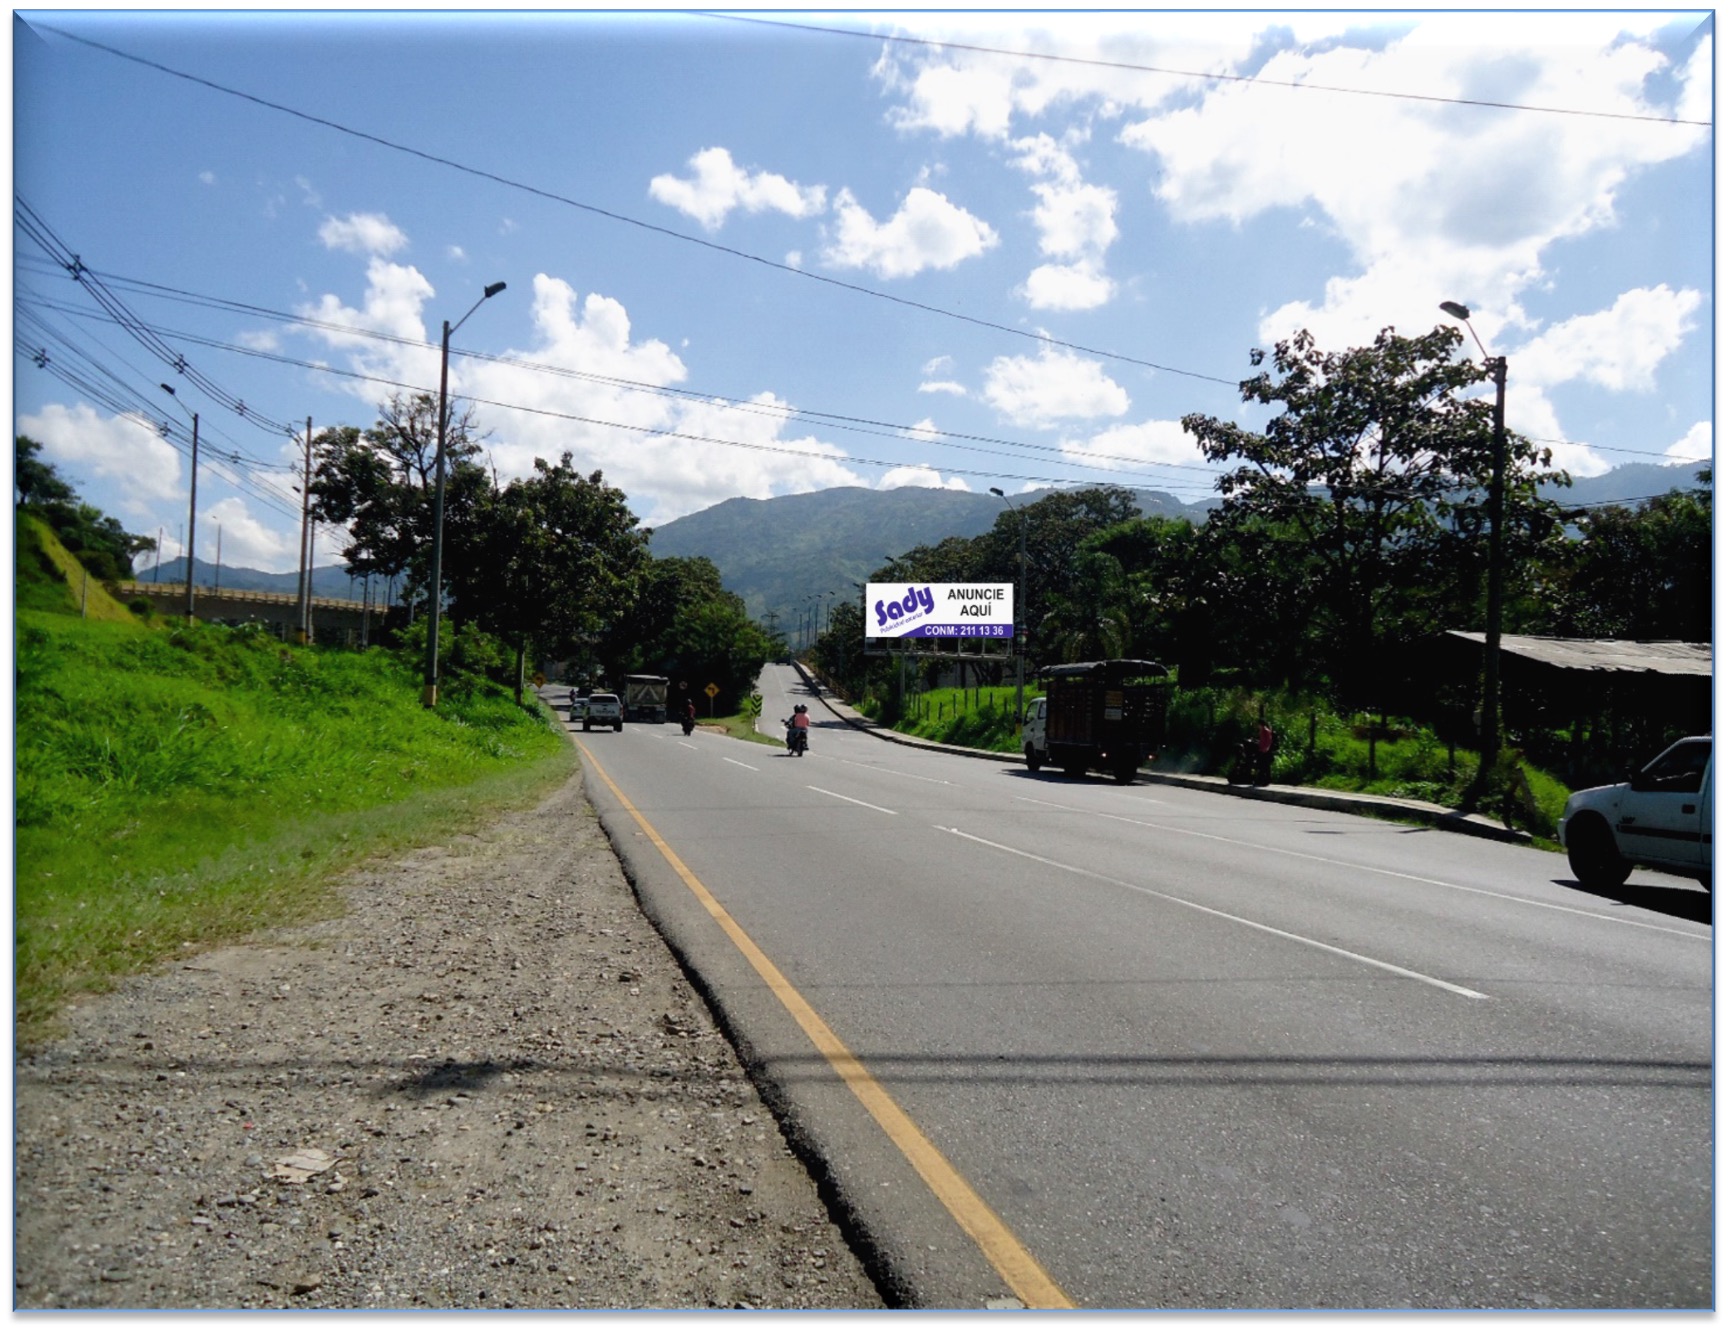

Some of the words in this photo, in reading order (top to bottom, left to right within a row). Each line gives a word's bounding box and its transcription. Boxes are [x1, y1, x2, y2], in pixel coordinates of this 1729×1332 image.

[947, 588, 1005, 600] ANUNCIE
[875, 586, 935, 627] Sady
[960, 602, 992, 617] AQUÍ
[925, 626, 958, 636] CONM:
[960, 626, 976, 636] 211
[979, 626, 990, 636] 13
[992, 626, 1004, 636] 36
